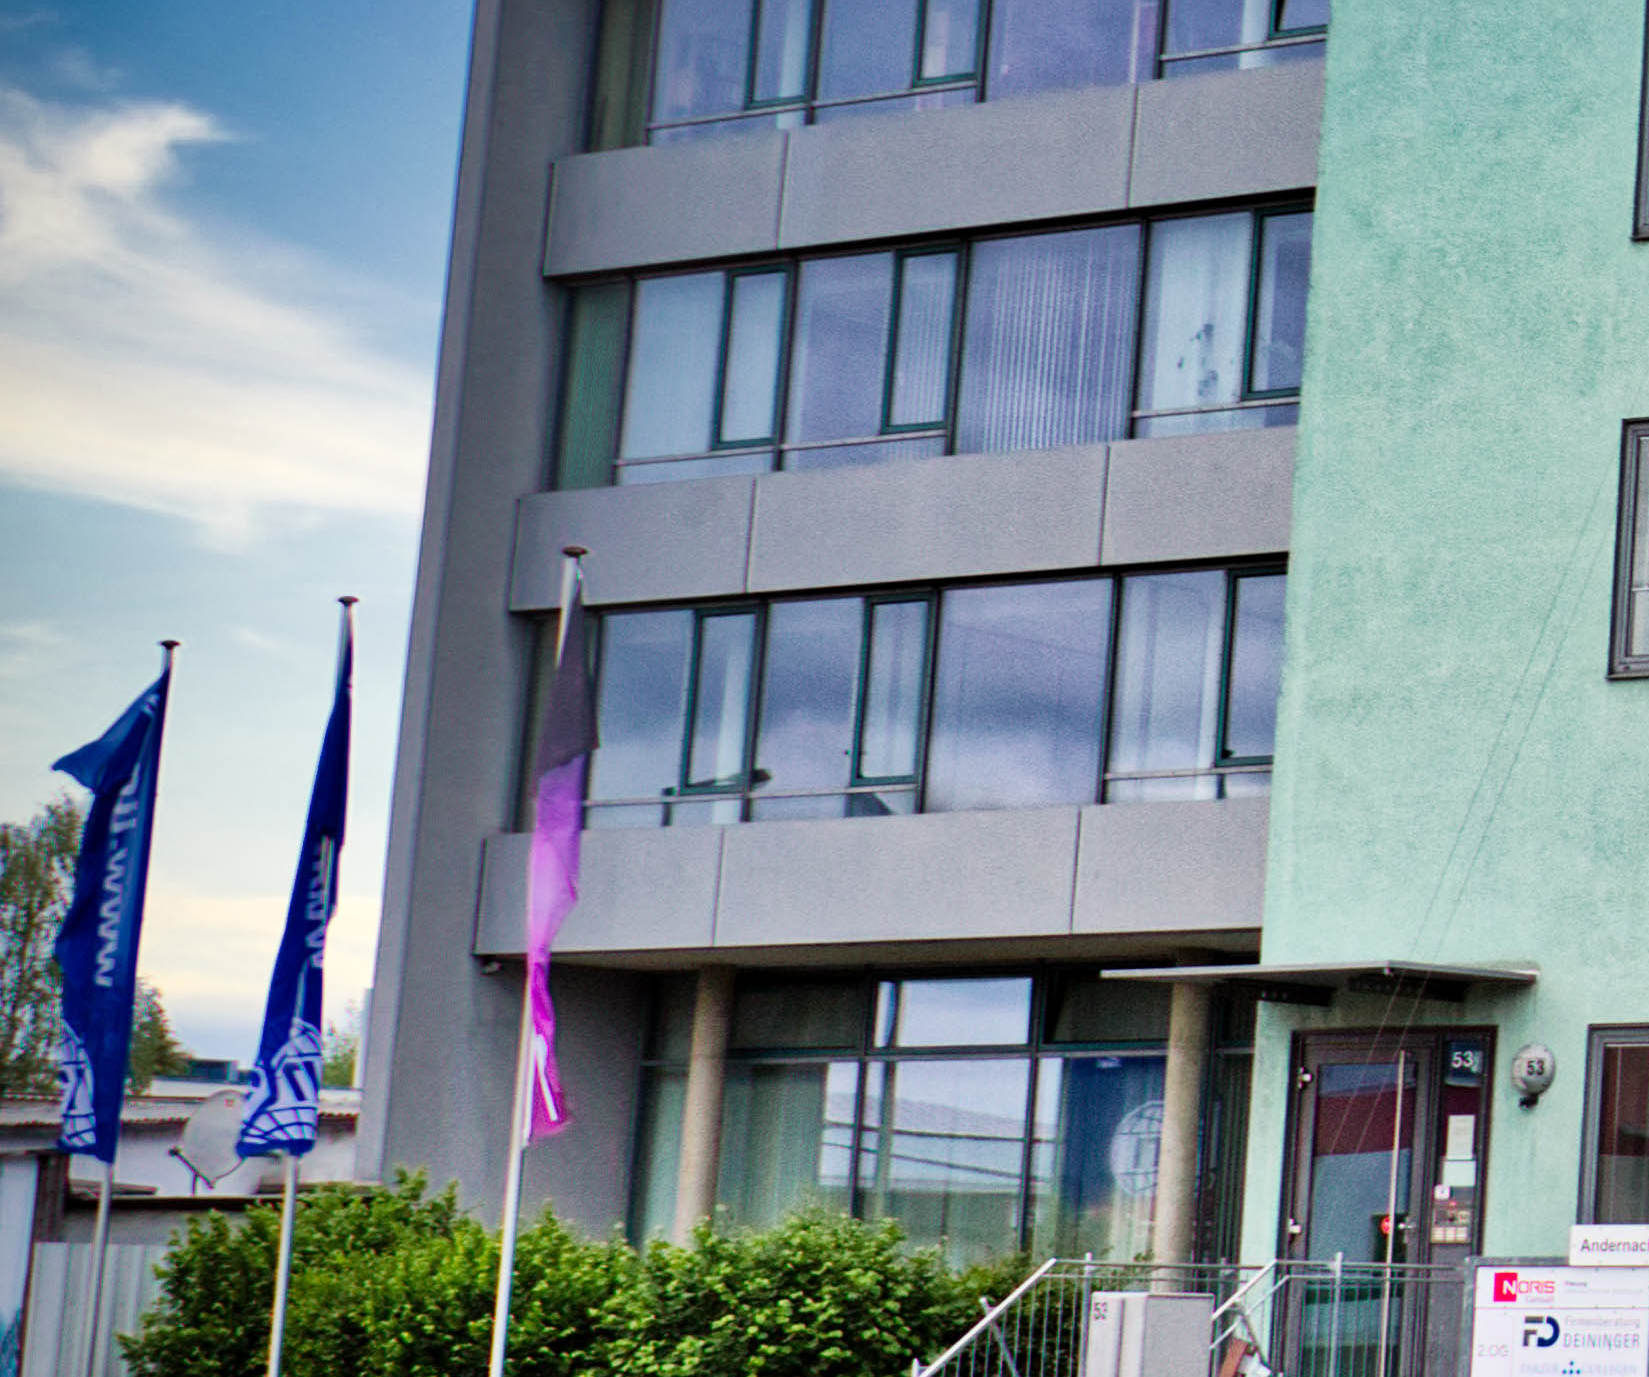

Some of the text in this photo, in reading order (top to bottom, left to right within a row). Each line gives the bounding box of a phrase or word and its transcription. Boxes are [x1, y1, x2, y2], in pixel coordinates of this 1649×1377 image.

[1451, 1051, 1474, 1069] 53
[1527, 1059, 1545, 1076] 53
[1502, 1280, 1555, 1295] NORIS
[1563, 1333, 1640, 1349] DEININGER
